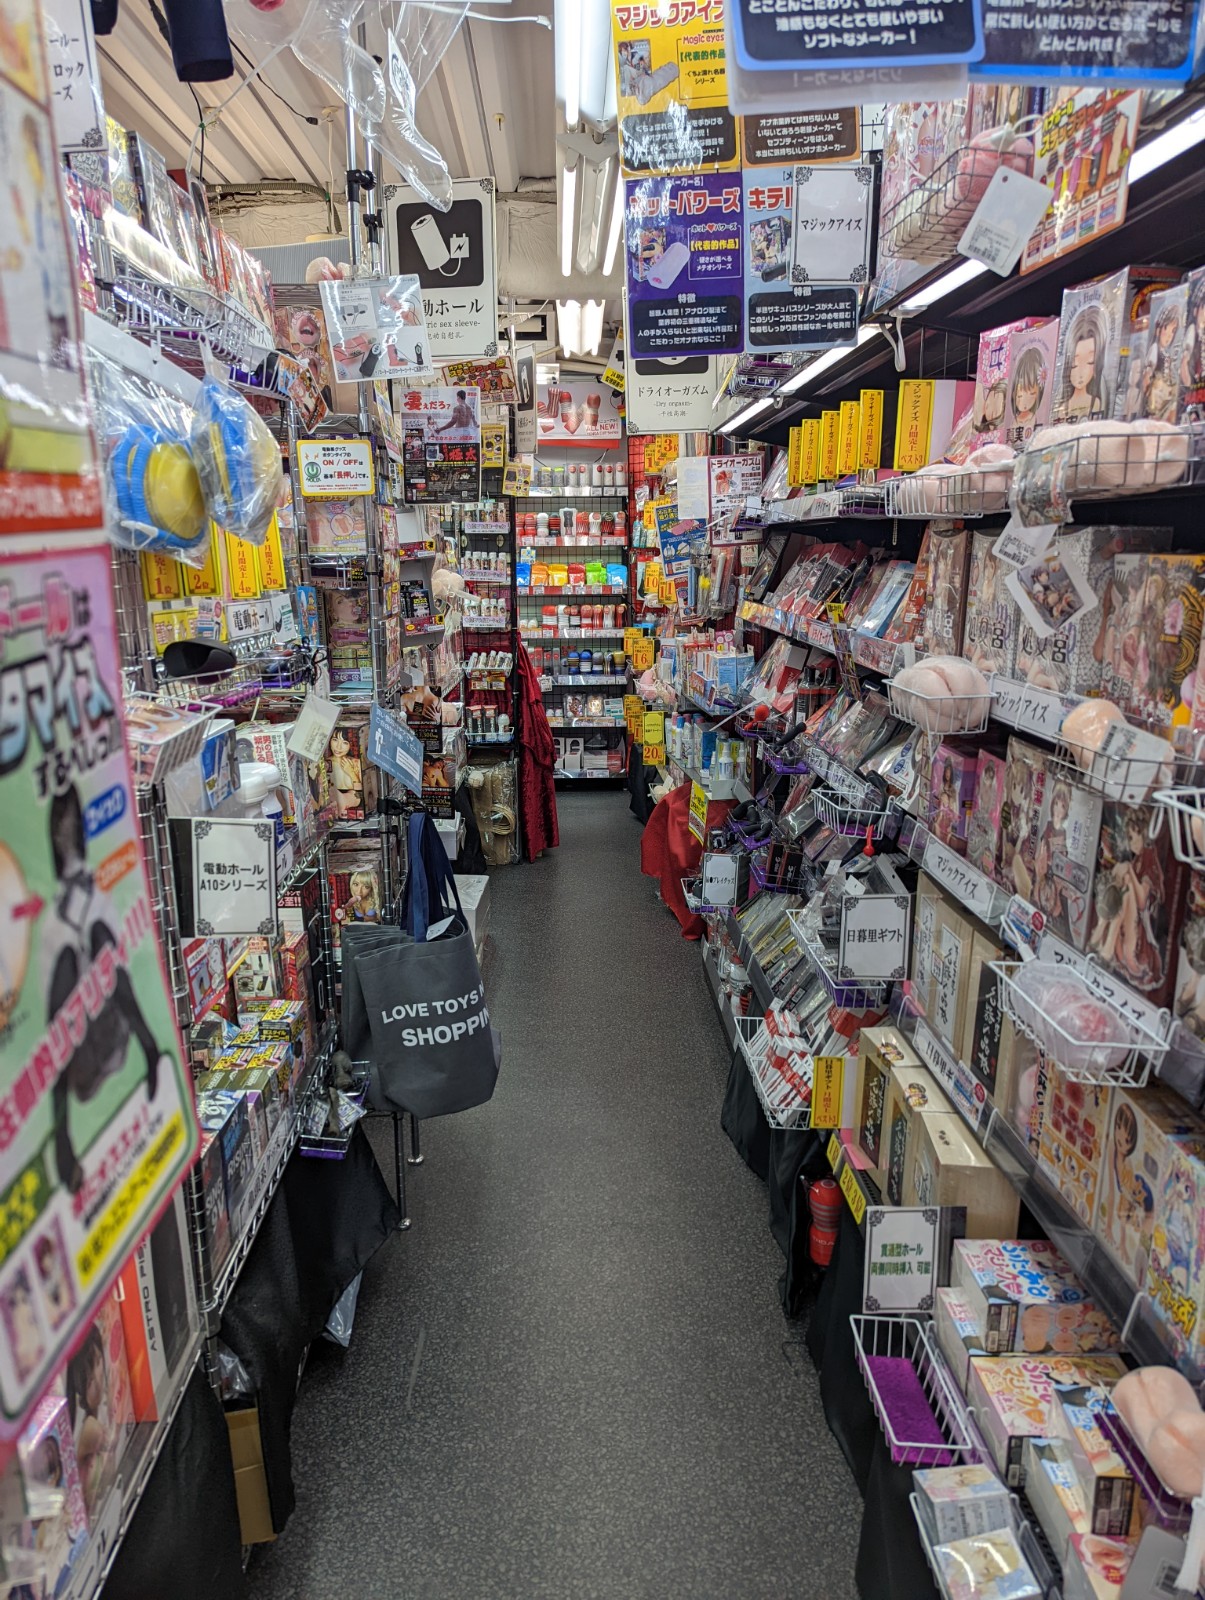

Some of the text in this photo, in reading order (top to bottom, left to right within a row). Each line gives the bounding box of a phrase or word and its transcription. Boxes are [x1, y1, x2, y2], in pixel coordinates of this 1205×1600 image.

[800, 217, 862, 232] マジックアイズ
[440, 320, 453, 328] sex
[638, 384, 709, 398] ドライオーガズム
[911, 383, 921, 422] マジックアイズ
[203, 862, 264, 877] 電動ホール
[936, 854, 980, 900] マジックアイズ
[200, 878, 268, 892] A10シリーズ
[846, 928, 904, 944] 日暮里ギフト
[381, 1002, 431, 1025] LOVE
[431, 990, 479, 1016] TOYS
